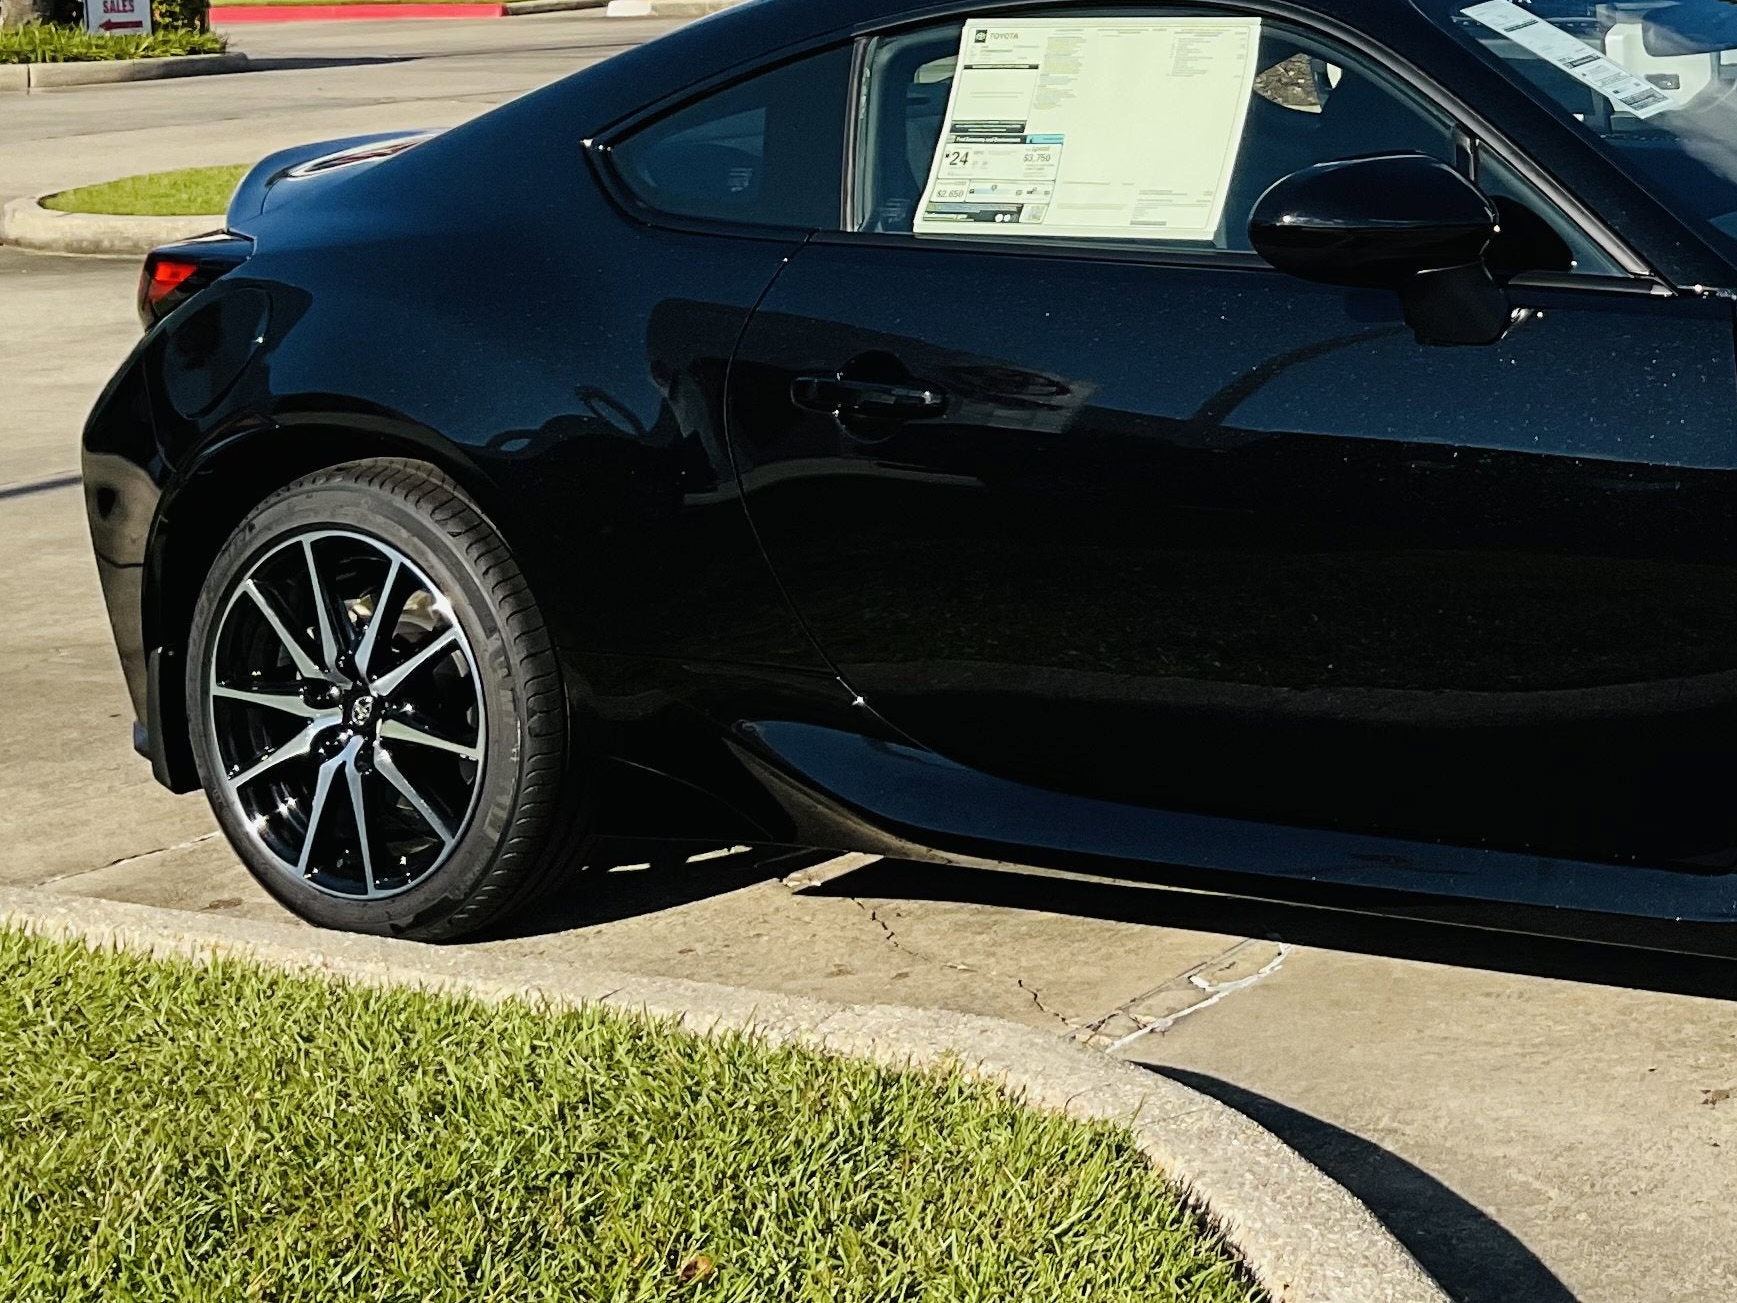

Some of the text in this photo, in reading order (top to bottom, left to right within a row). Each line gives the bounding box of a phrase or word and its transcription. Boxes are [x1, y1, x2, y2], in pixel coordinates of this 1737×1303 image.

[103, 0, 135, 13] SALES
[989, 32, 1019, 40] TOYOTA
[949, 151, 969, 166] 24
